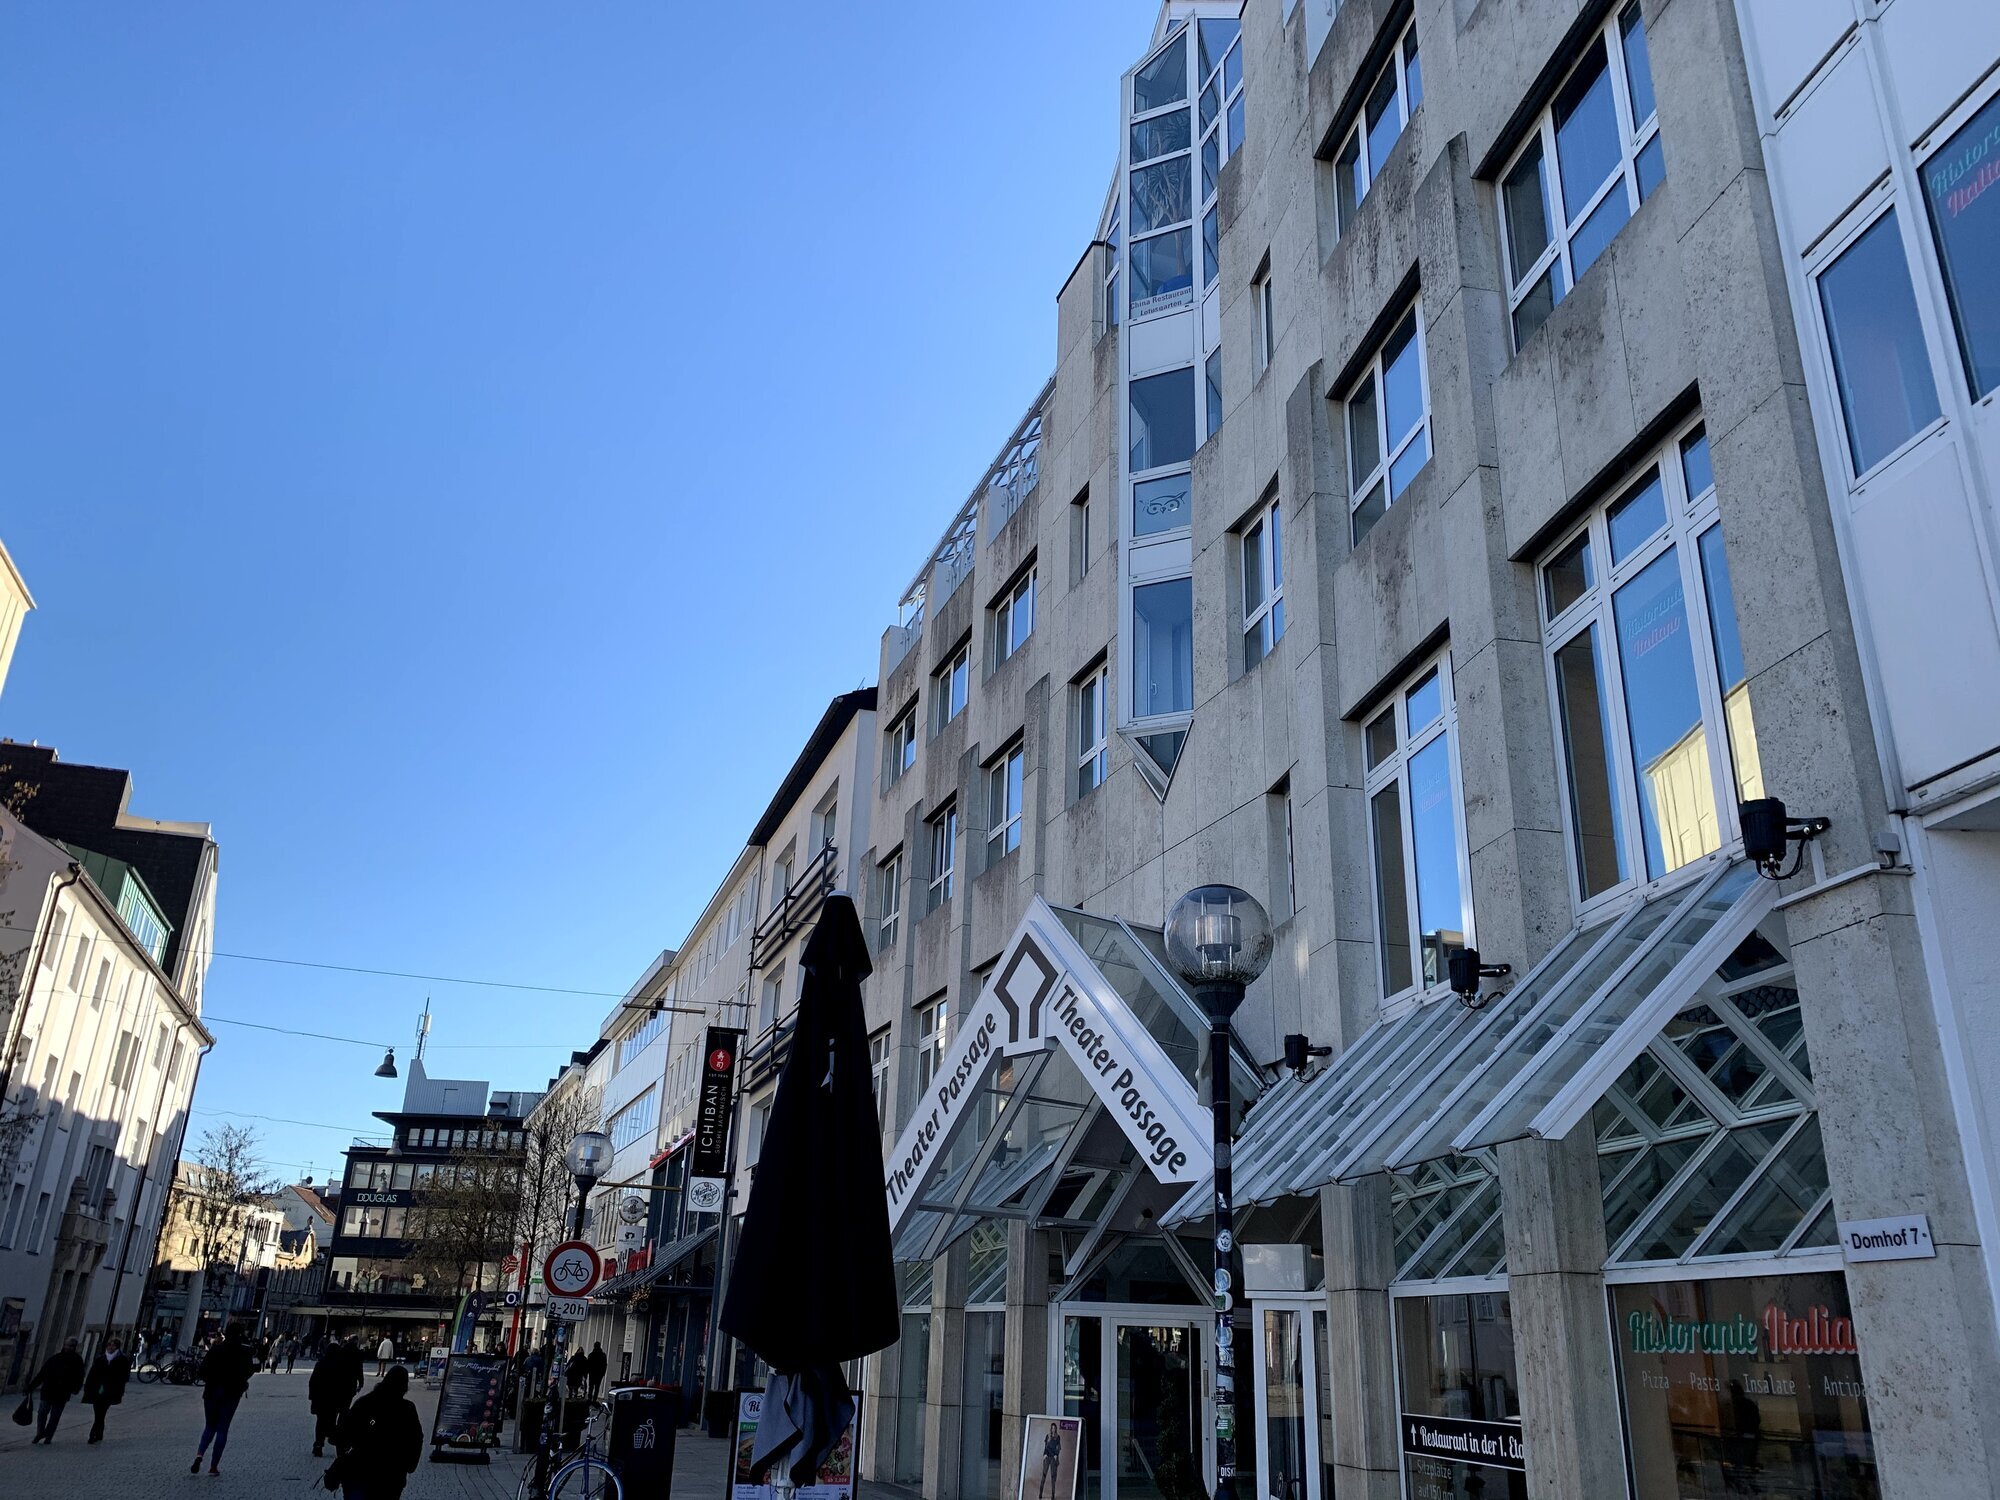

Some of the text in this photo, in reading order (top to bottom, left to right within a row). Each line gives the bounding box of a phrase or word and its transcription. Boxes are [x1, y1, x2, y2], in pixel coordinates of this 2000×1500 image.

[1131, 287, 1192, 310] China Restaurant
[1140, 300, 1182, 316] Lotusgarten
[1053, 984, 1187, 1176] Theater Passage
[701, 1085, 719, 1154] ICHIBAN
[718, 1086, 727, 1127] JAPANISCH
[886, 1012, 997, 1206] Theater Passage
[715, 1130, 723, 1154] SUSHI
[357, 1193, 397, 1203] DOUGLAS
[1850, 1227, 1918, 1250] Domhof 7
[1628, 1300, 1858, 1356] Ristorante Italia
[1641, 1369, 1670, 1391] Pizza
[1690, 1371, 1721, 1393] Pasta
[1742, 1373, 1797, 1396] Insalate
[1420, 1425, 1468, 1452] Restaurant
[1469, 1432, 1480, 1454] in
[1481, 1434, 1498, 1456] der
[1498, 1435, 1507, 1457] 1.
[1416, 1459, 1452, 1480] Sitzplätze
